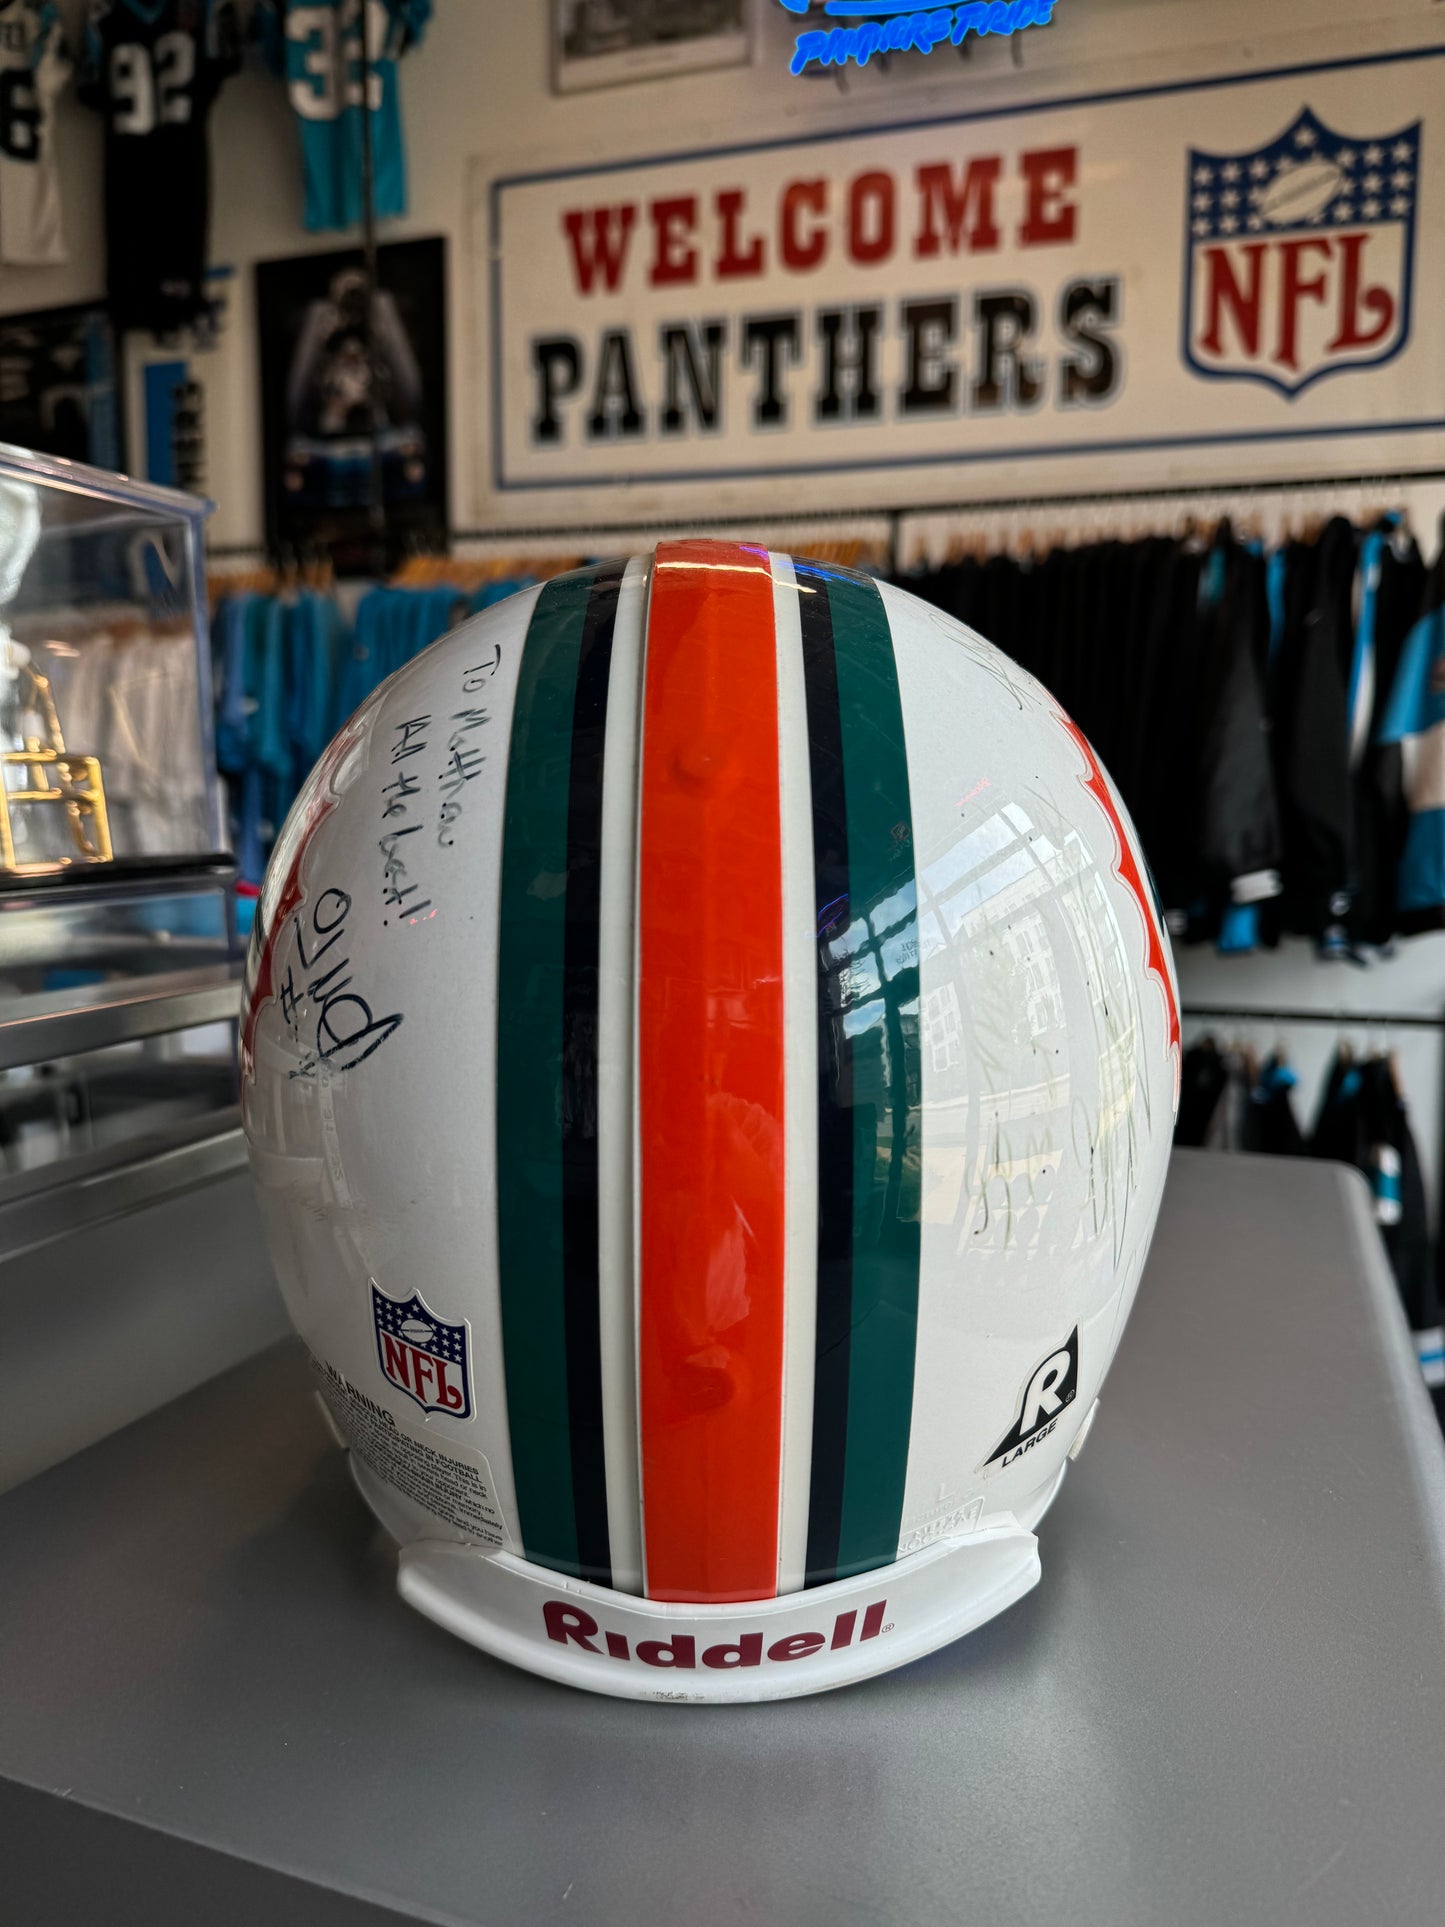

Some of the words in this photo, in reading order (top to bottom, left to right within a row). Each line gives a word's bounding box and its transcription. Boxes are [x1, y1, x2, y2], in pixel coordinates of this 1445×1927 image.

[108, 30, 197, 136] 92
[561, 145, 1080, 298] WELCOME
[1197, 230, 1395, 372] NFL
[530, 274, 1120, 449] PANTHERS
[380, 1330, 463, 1410] NFL
[1001, 1418, 1058, 1469] LARGE
[541, 1598, 888, 1670] Riddell
